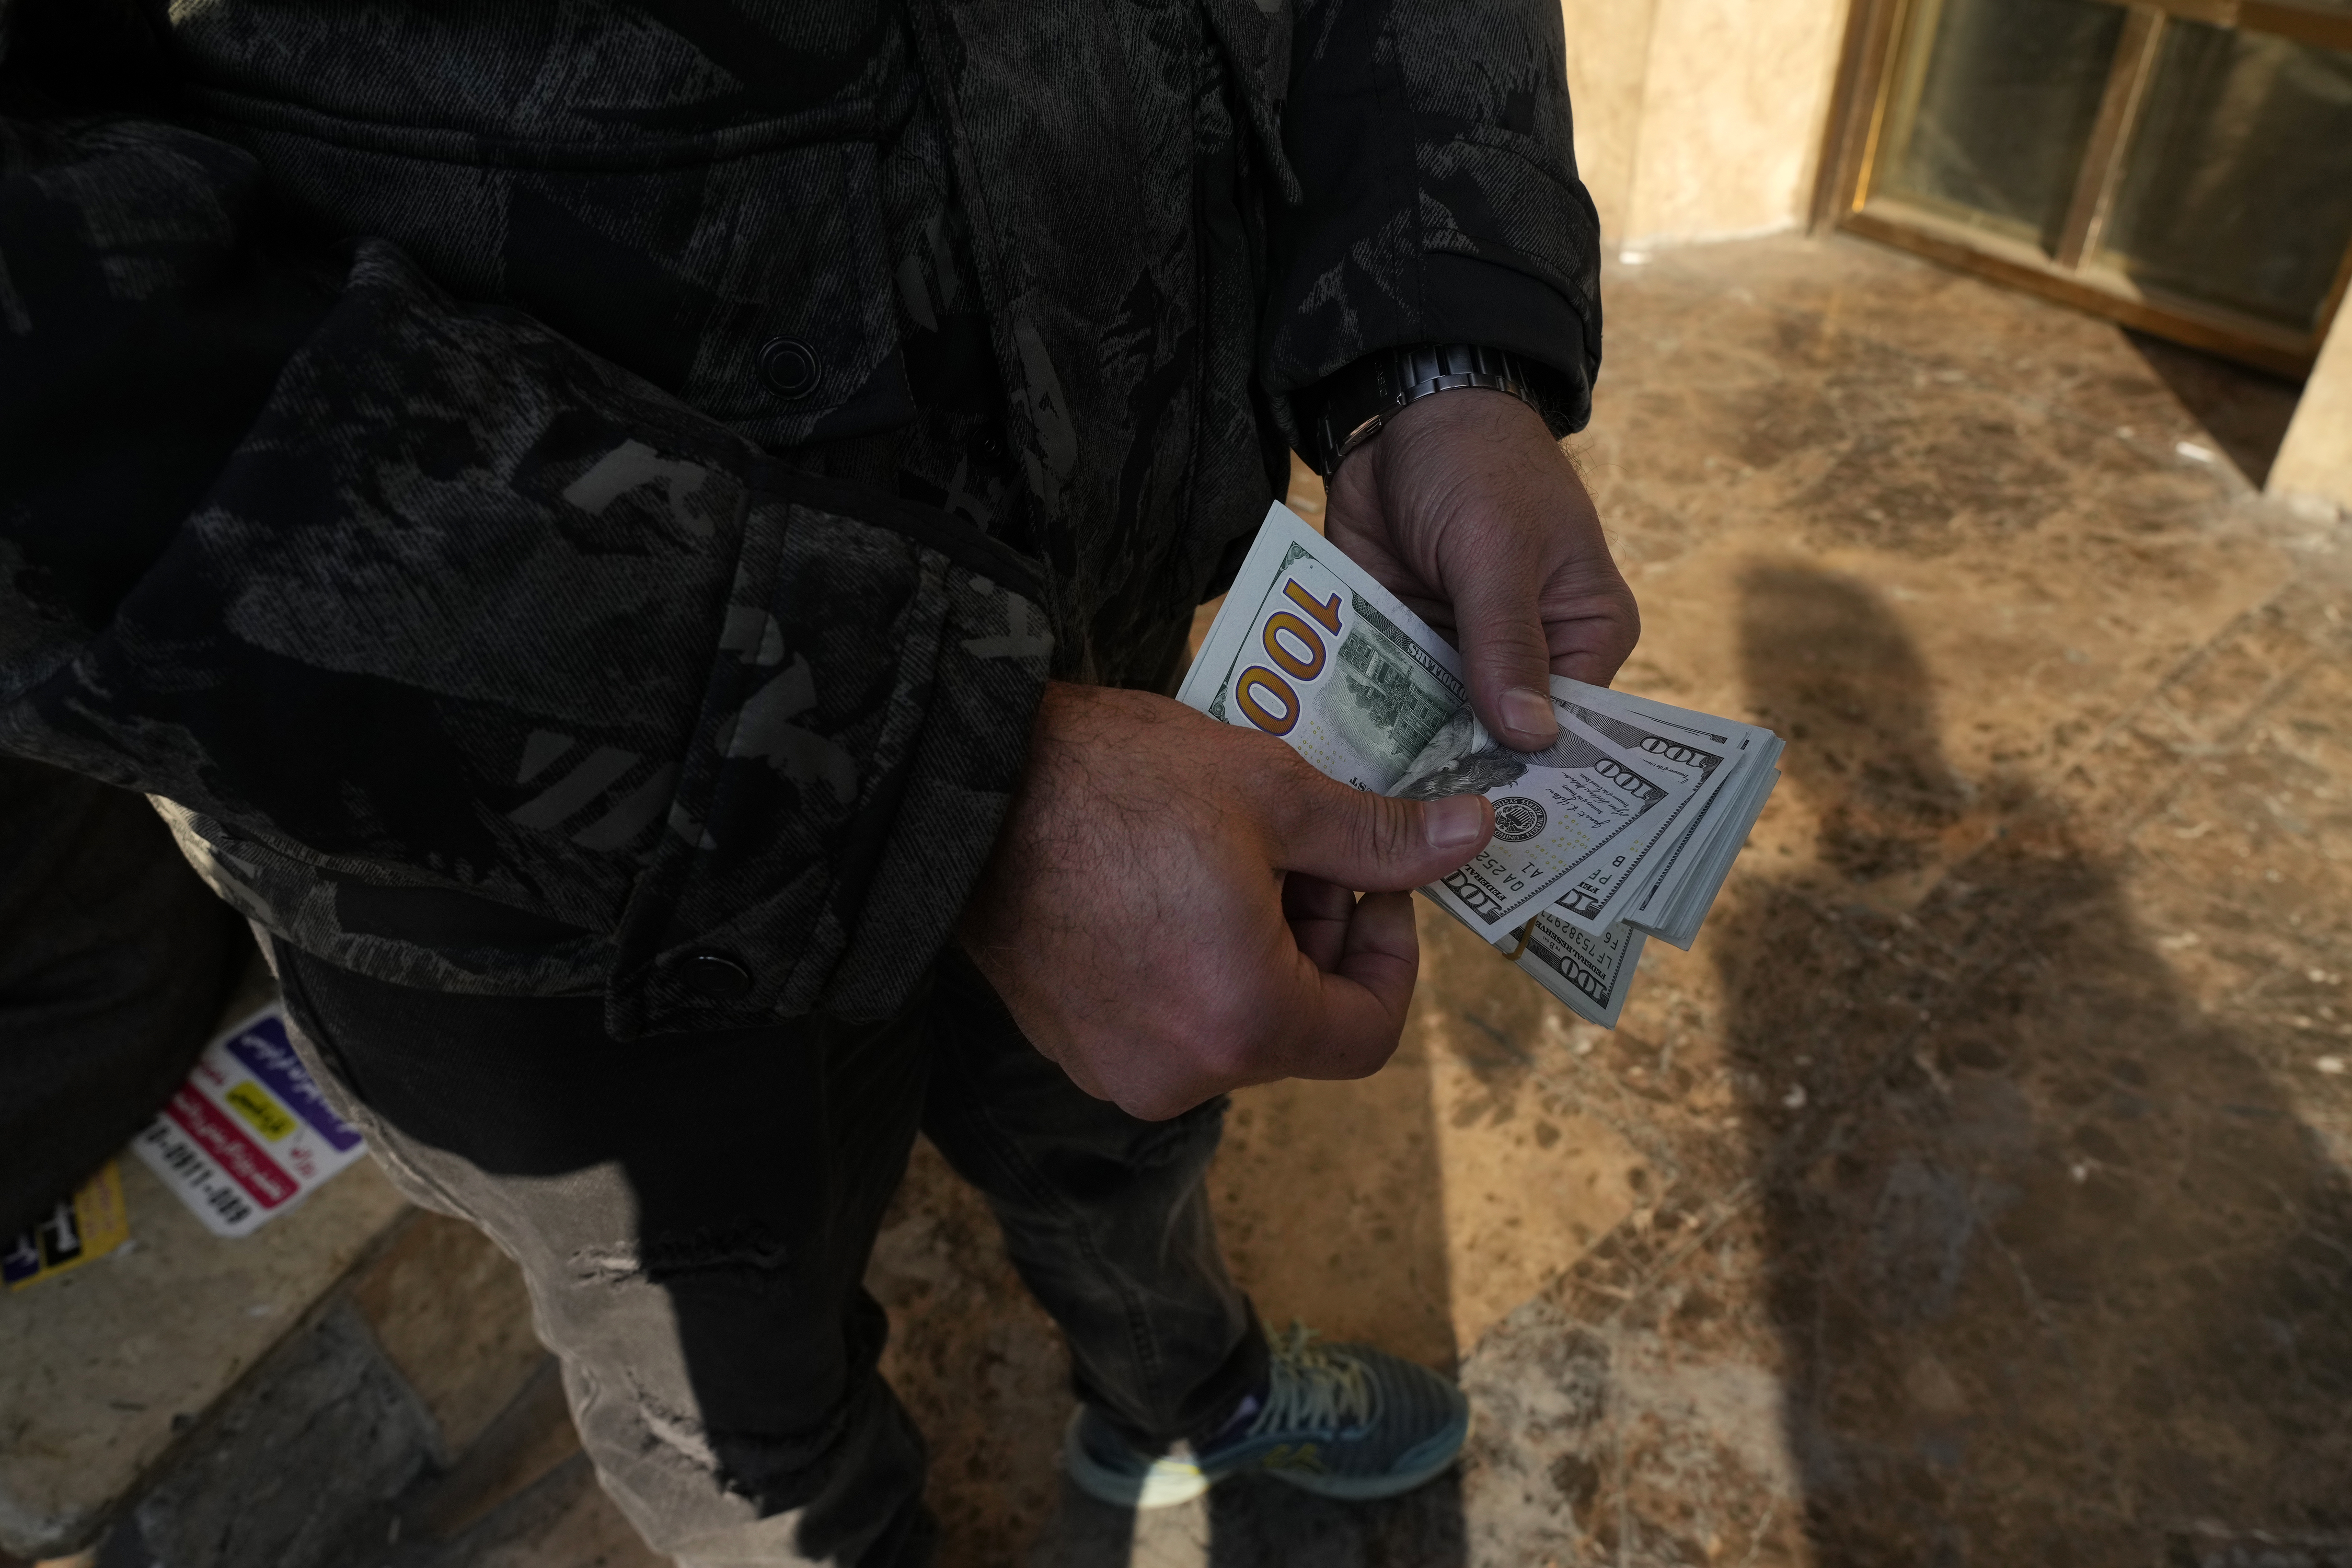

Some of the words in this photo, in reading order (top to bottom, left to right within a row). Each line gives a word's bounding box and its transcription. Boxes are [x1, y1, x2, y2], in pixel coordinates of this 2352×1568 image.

[1374, 360, 1388, 397] CASIO
[1235, 577, 1343, 739] 100
[1639, 735, 1712, 768] 100
[1589, 780, 1603, 791] United
[1594, 758, 1657, 800] 100
[1493, 798, 1517, 809] SYSTEM
[1520, 799, 1542, 816] RESERVE
[1586, 800, 1603, 814] Secretary
[1611, 794, 1629, 808] Treasurer
[1526, 815, 1543, 837] FEDERAL
[1576, 809, 1609, 828] Janet
[1493, 829, 1520, 840] UNITED
[1521, 861, 1543, 879] A1
[1440, 869, 1502, 917] 100
[1462, 863, 1507, 901] FEDERAL
[1534, 920, 1573, 952] RESERVE
[1603, 931, 1619, 950] F6
[1572, 949, 1606, 980] FEDERAL
[1560, 956, 1607, 1000] 100
